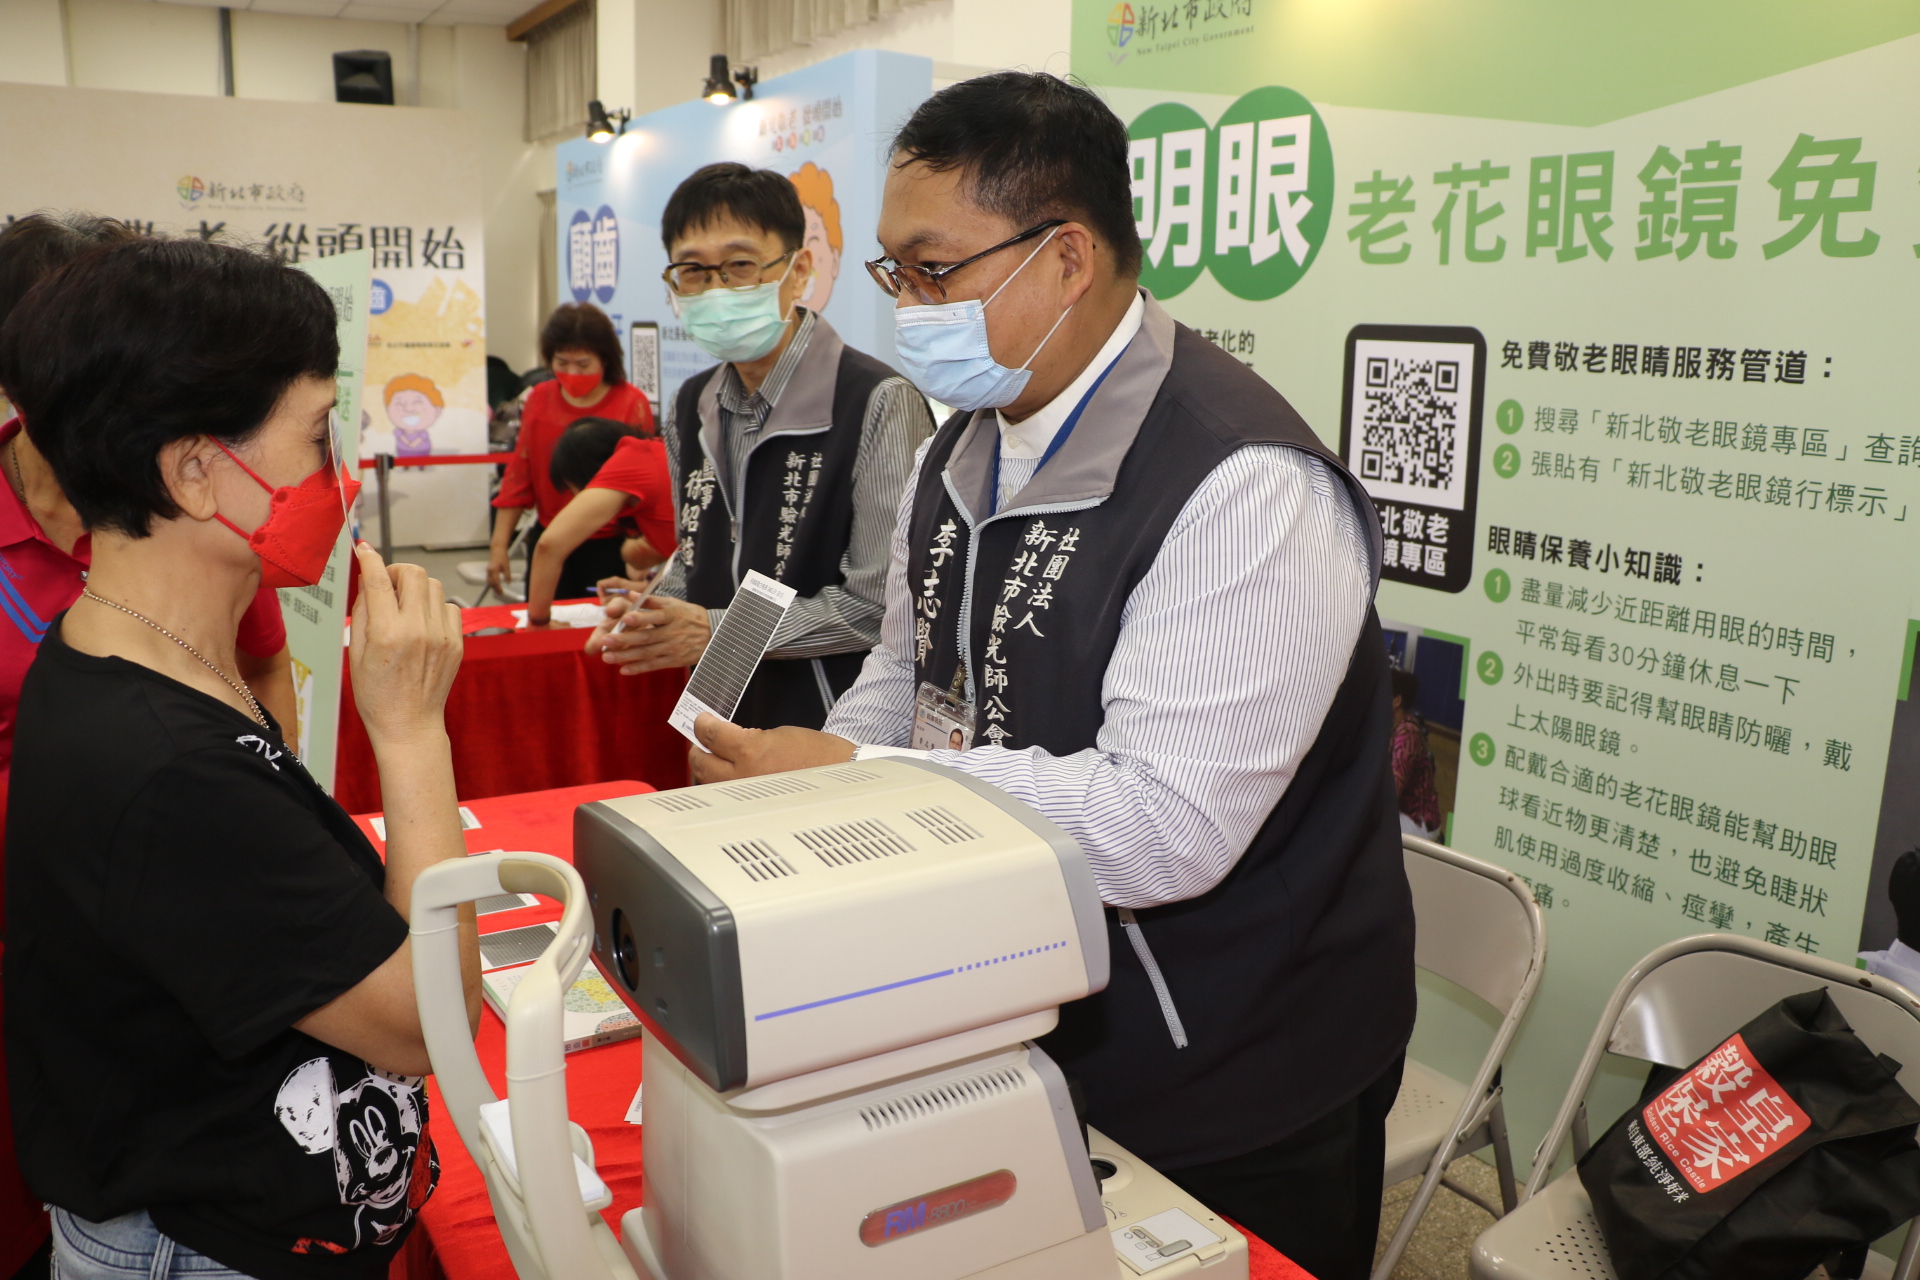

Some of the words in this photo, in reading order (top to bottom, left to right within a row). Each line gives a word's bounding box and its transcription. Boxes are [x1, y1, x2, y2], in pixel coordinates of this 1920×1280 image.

[1136, 46, 1152, 56] New
[1155, 40, 1181, 53] Taipei
[1183, 36, 1200, 47] City
[1203, 25, 1255, 42] Government
[1128, 114, 1314, 269] 明眼
[1346, 132, 1920, 266] 老花眼鏡免
[264, 222, 465, 270] 從頭開始
[1192, 328, 1255, 355] 老化的
[1500, 339, 1832, 384] 免費敬老眼睛服務管道：
[774, 451, 806, 582] 新北市驗光師公
[1374, 503, 1450, 544] 北敬老
[1532, 450, 1907, 522] 張貼有「新北敬老眼鏡行標示」
[915, 518, 958, 669] 李志賢
[1013, 527, 1080, 638] 社團法人
[1487, 524, 1704, 587] 眼睛保養小知識：
[982, 520, 1059, 747] 新北市驗光師公會
[1515, 618, 1800, 705] 平常每看30分鐘休息一下
[1521, 577, 1855, 664] 盡量減少近距離用眼的時間，
[1507, 704, 1638, 758] 上太陽眼鏡。
[1513, 661, 1853, 773] 外出時要記得幫眼睛防曬，戴
[1504, 744, 1838, 871] 配戴合適的老花眼鏡能幫助眼
[1499, 786, 1829, 918] 球看近物更清楚，也避免睫狀
[1646, 1106, 1661, 1133] Golden
[1659, 1132, 1680, 1158] Rice
[1679, 1157, 1707, 1189] Castle
